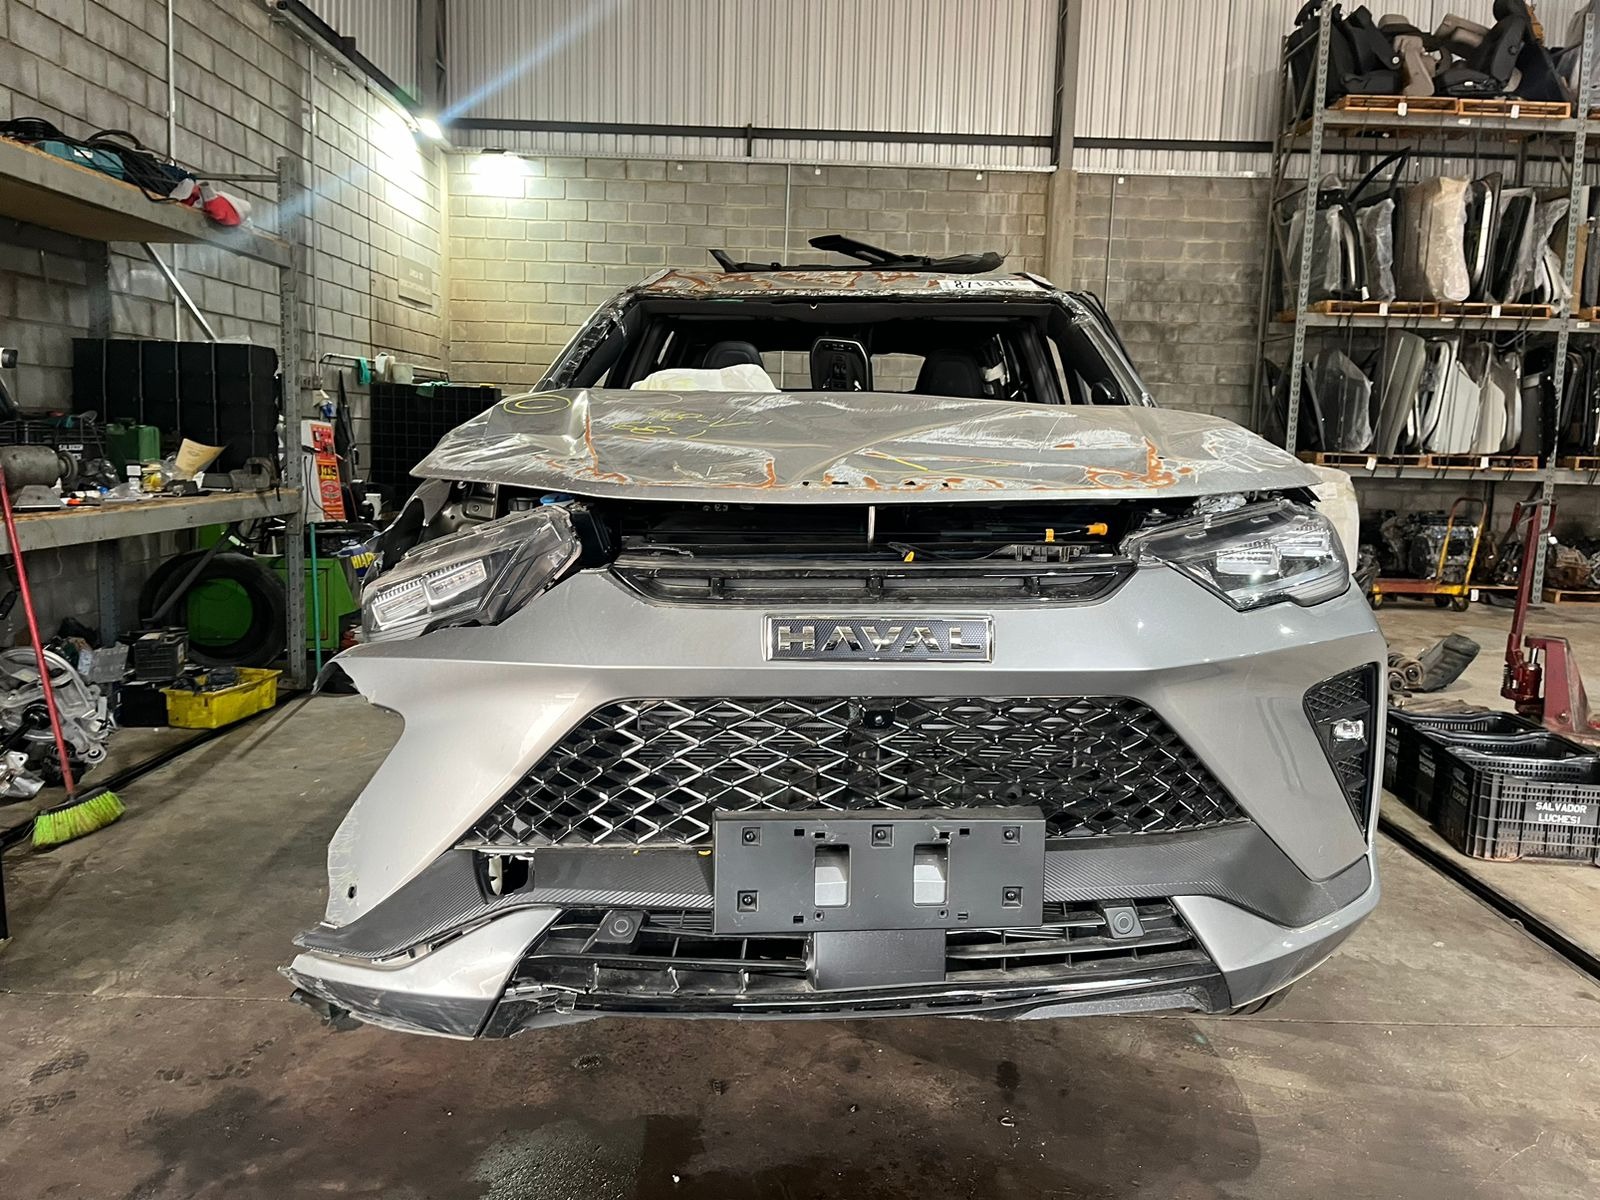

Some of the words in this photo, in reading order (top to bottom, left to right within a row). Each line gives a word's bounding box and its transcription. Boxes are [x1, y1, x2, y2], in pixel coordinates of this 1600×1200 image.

[777, 626, 982, 652] HAVAL
[1535, 802, 1587, 814] SALVADOR
[1538, 813, 1581, 824] LUCHESI
